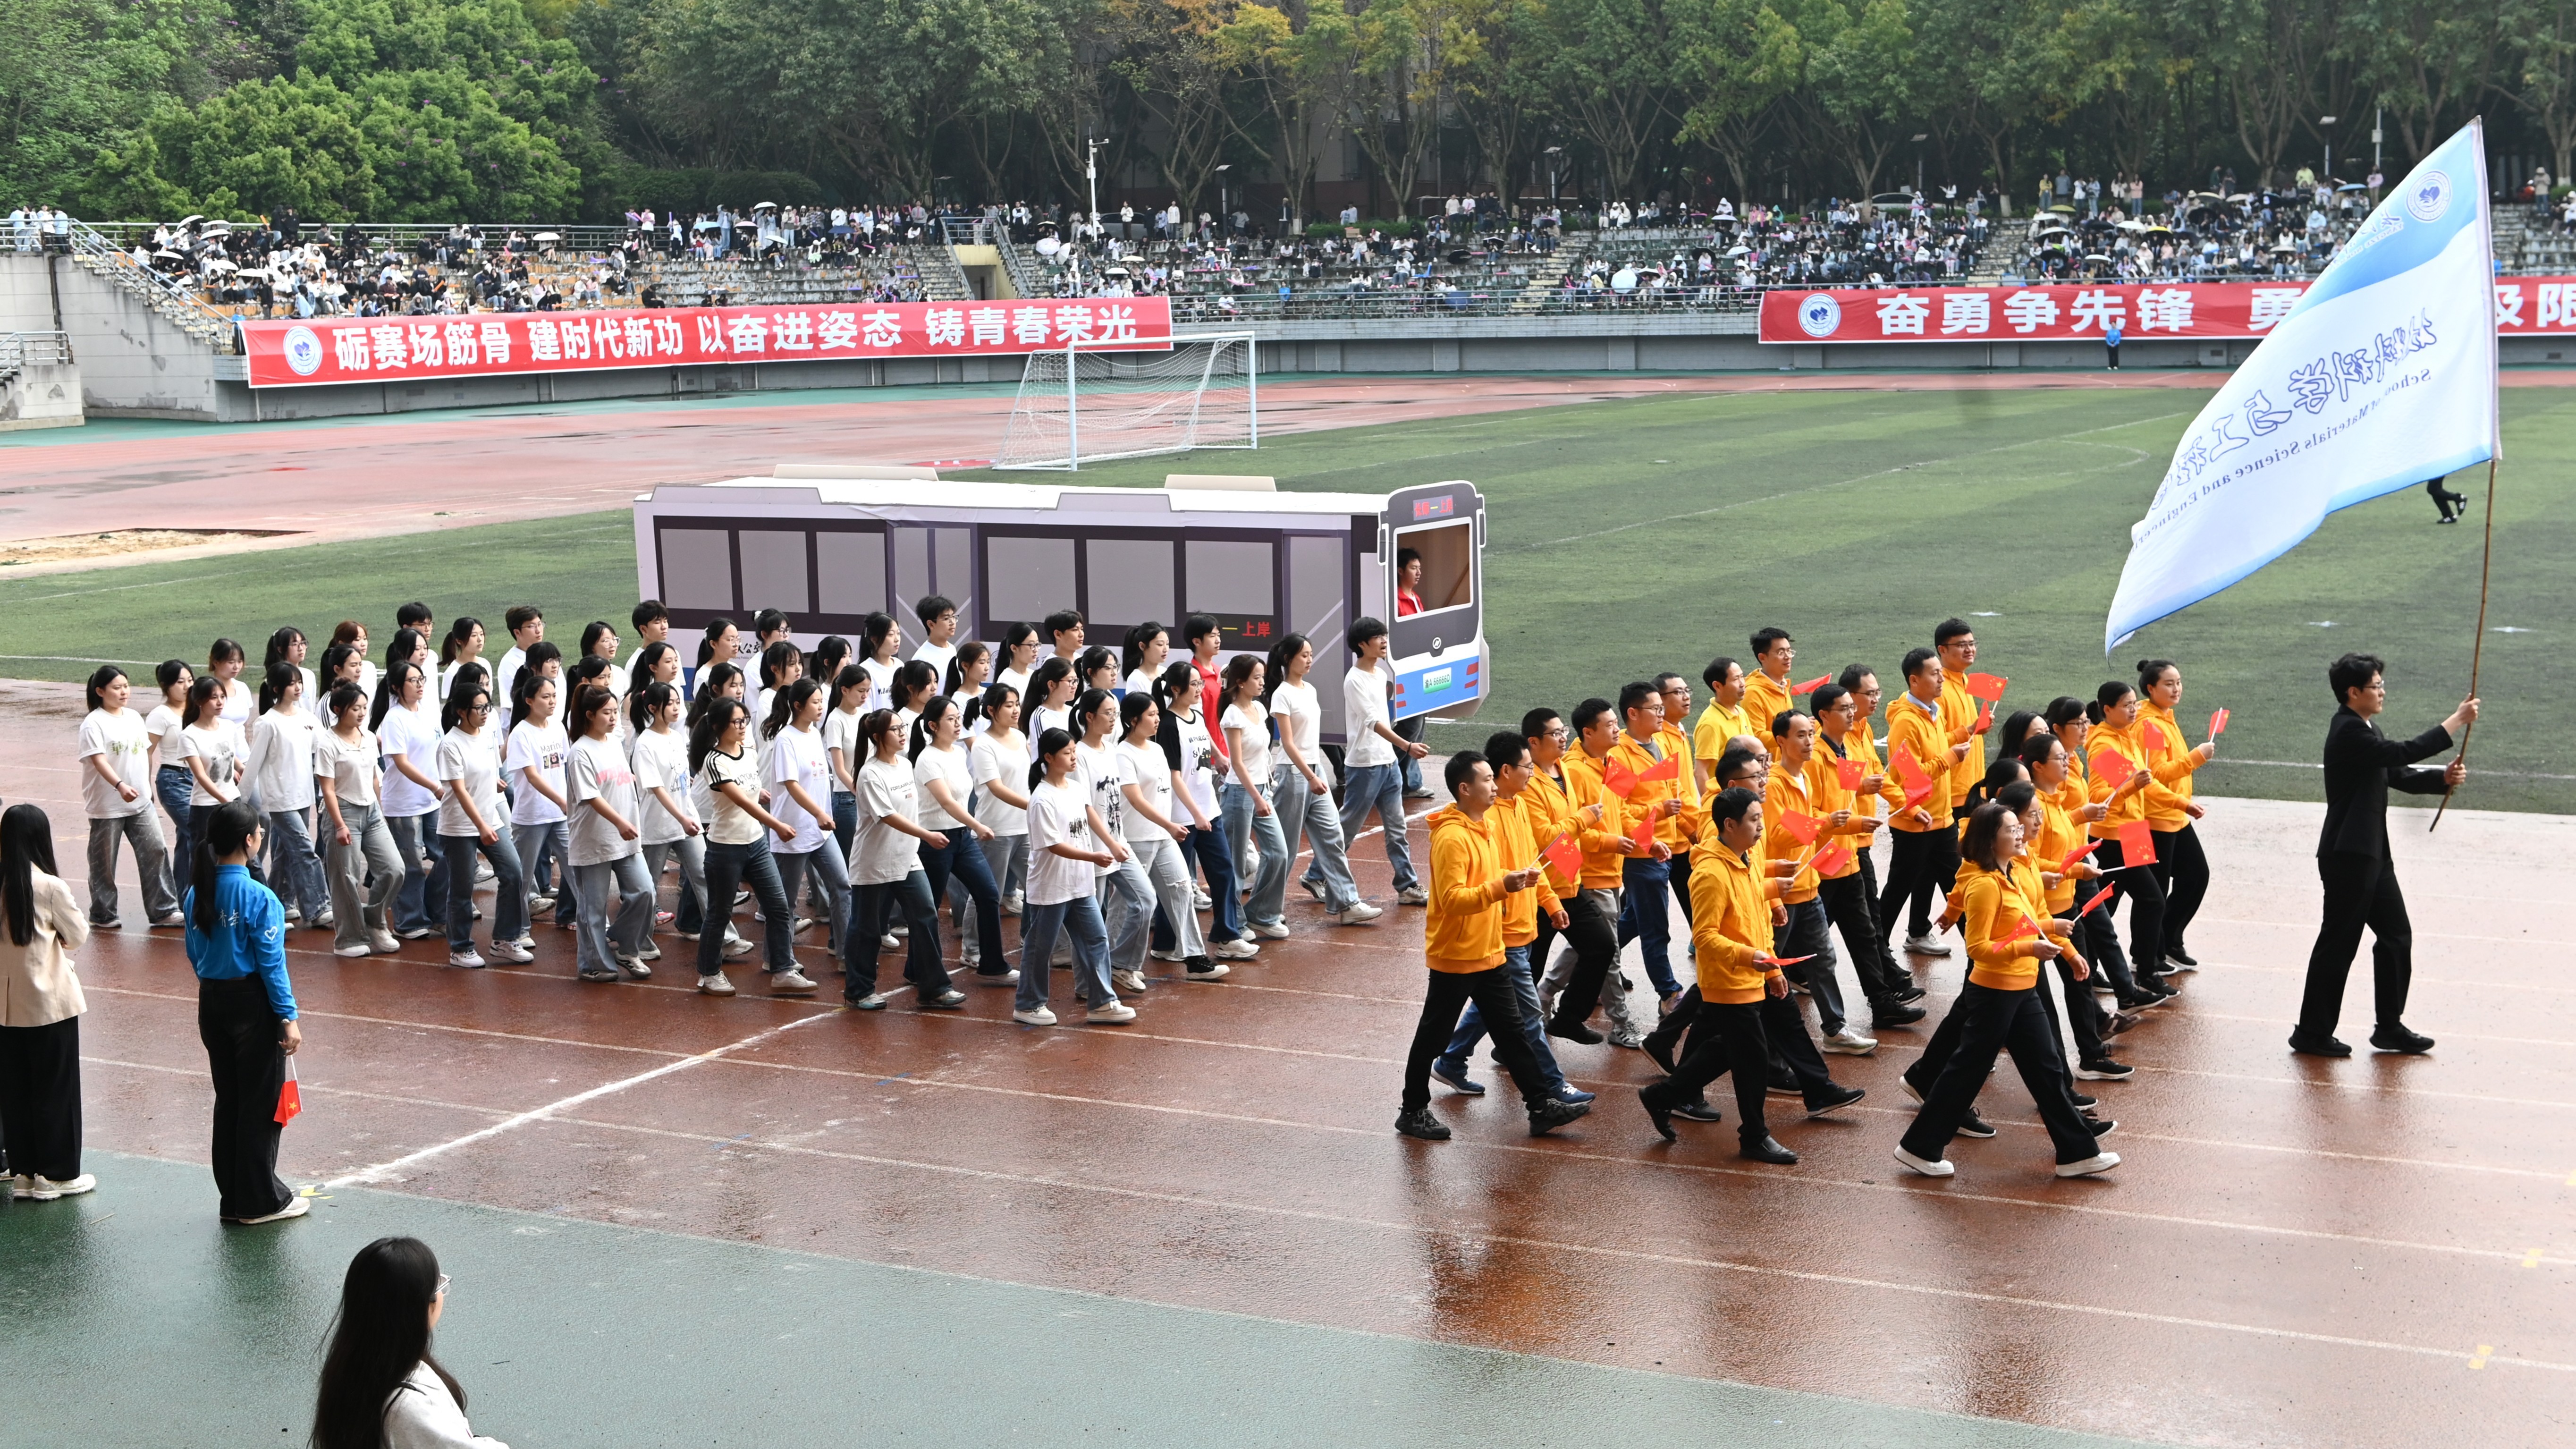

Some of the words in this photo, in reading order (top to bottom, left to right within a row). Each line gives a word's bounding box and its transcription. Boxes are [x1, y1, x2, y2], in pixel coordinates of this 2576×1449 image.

[1876, 288, 2194, 335] 奋勇争先锋
[332, 321, 511, 371] 砺赛场筋骨
[527, 315, 683, 362] 建时代新功
[697, 309, 902, 354] 以奋进姿态
[924, 305, 1137, 347] 铸青春荣光
[738, 641, 761, 654] 公交
